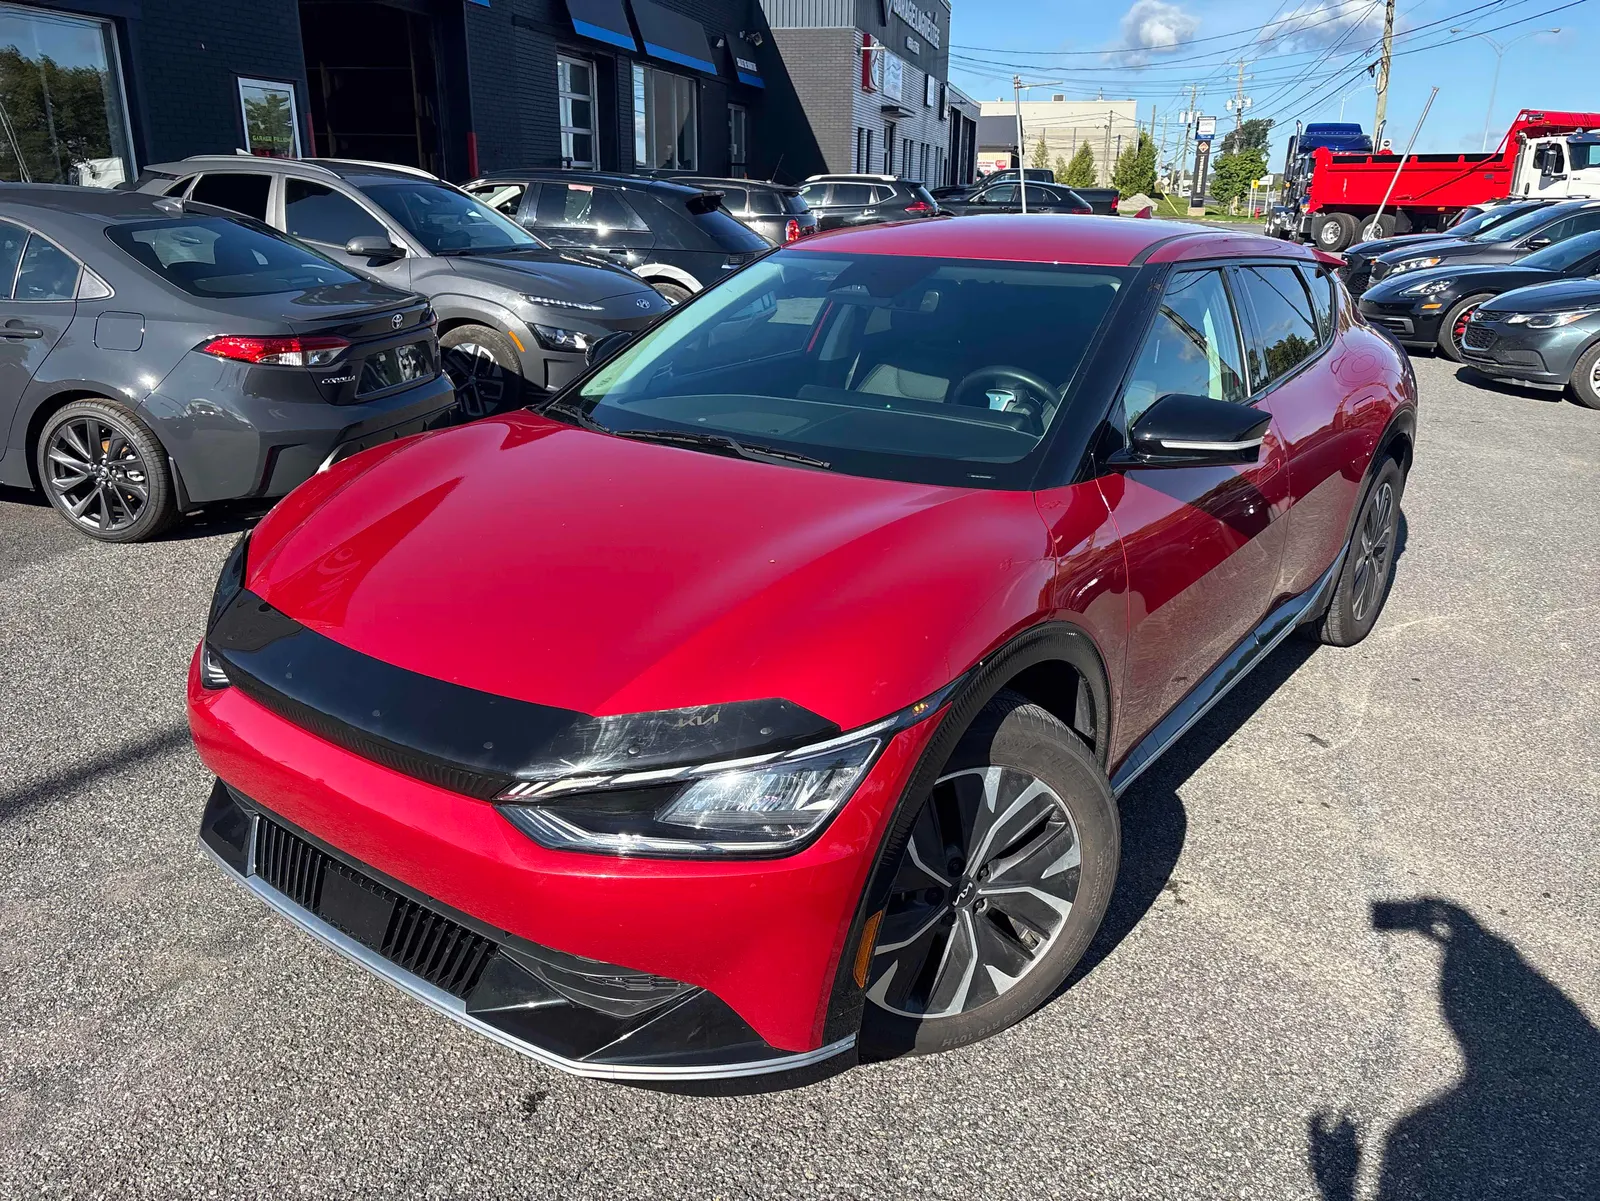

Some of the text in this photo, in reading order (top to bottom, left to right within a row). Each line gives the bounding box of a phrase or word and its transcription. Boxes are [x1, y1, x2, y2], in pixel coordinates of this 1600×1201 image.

[1196, 156, 1205, 193] INTERNATIONAL
[321, 375, 356, 384] COROLLA
[679, 712, 719, 728] KIA
[951, 882, 973, 907] KIA
[941, 1032, 974, 1047] 101H
